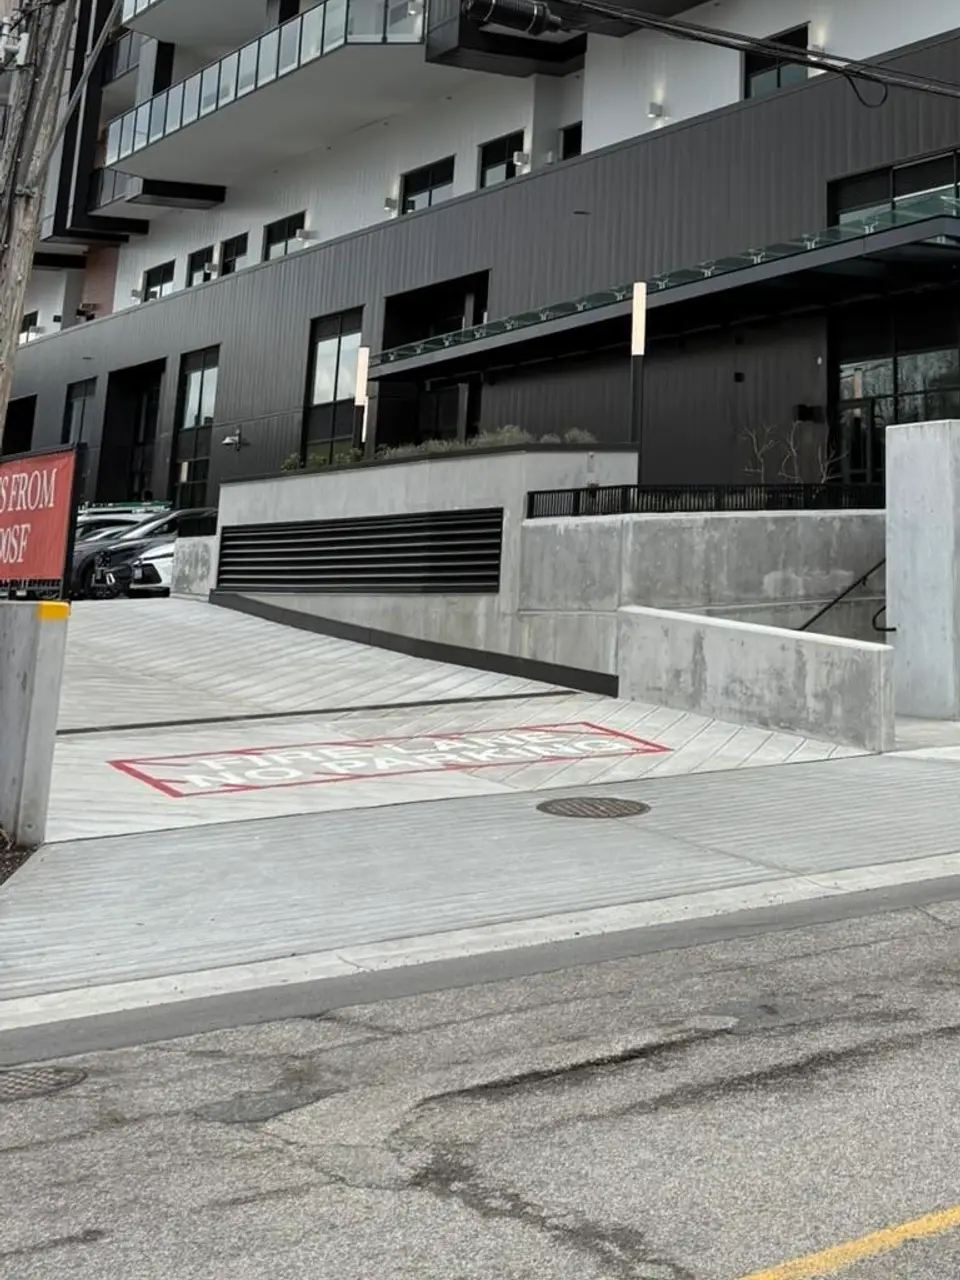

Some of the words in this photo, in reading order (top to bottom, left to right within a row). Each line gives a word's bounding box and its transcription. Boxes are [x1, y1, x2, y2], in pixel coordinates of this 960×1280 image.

[8, 468, 57, 511] FROM
[183, 767, 303, 787] NO
[321, 739, 633, 774] PARKING
[199, 746, 373, 770] FIRE
[382, 731, 563, 754] LANE
